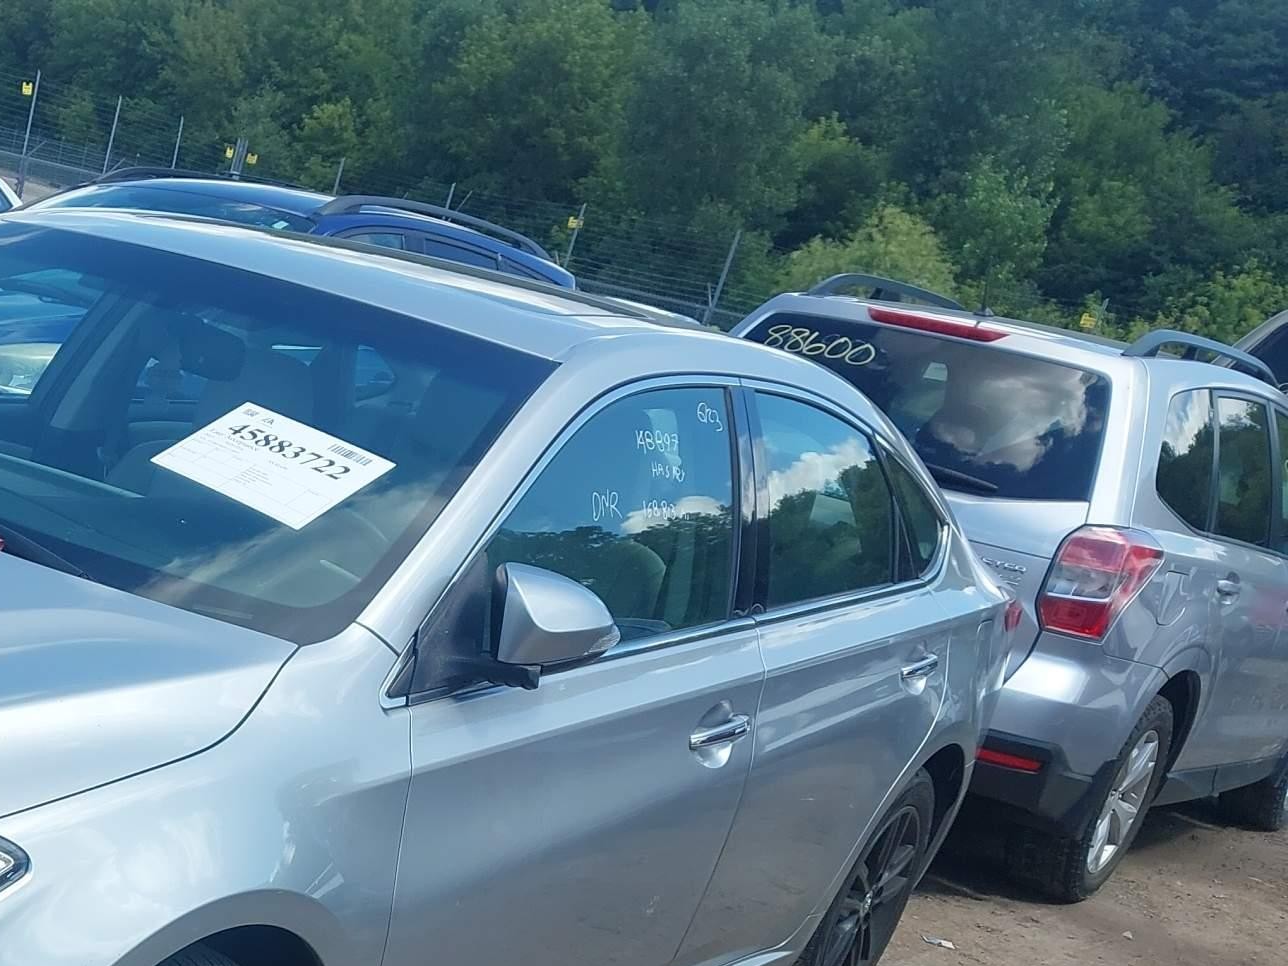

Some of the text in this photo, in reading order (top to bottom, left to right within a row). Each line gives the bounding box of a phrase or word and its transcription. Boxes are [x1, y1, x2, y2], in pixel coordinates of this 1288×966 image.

[763, 324, 876, 366] 88600
[227, 423, 352, 481] 45883722
[592, 488, 623, 522] DNR
